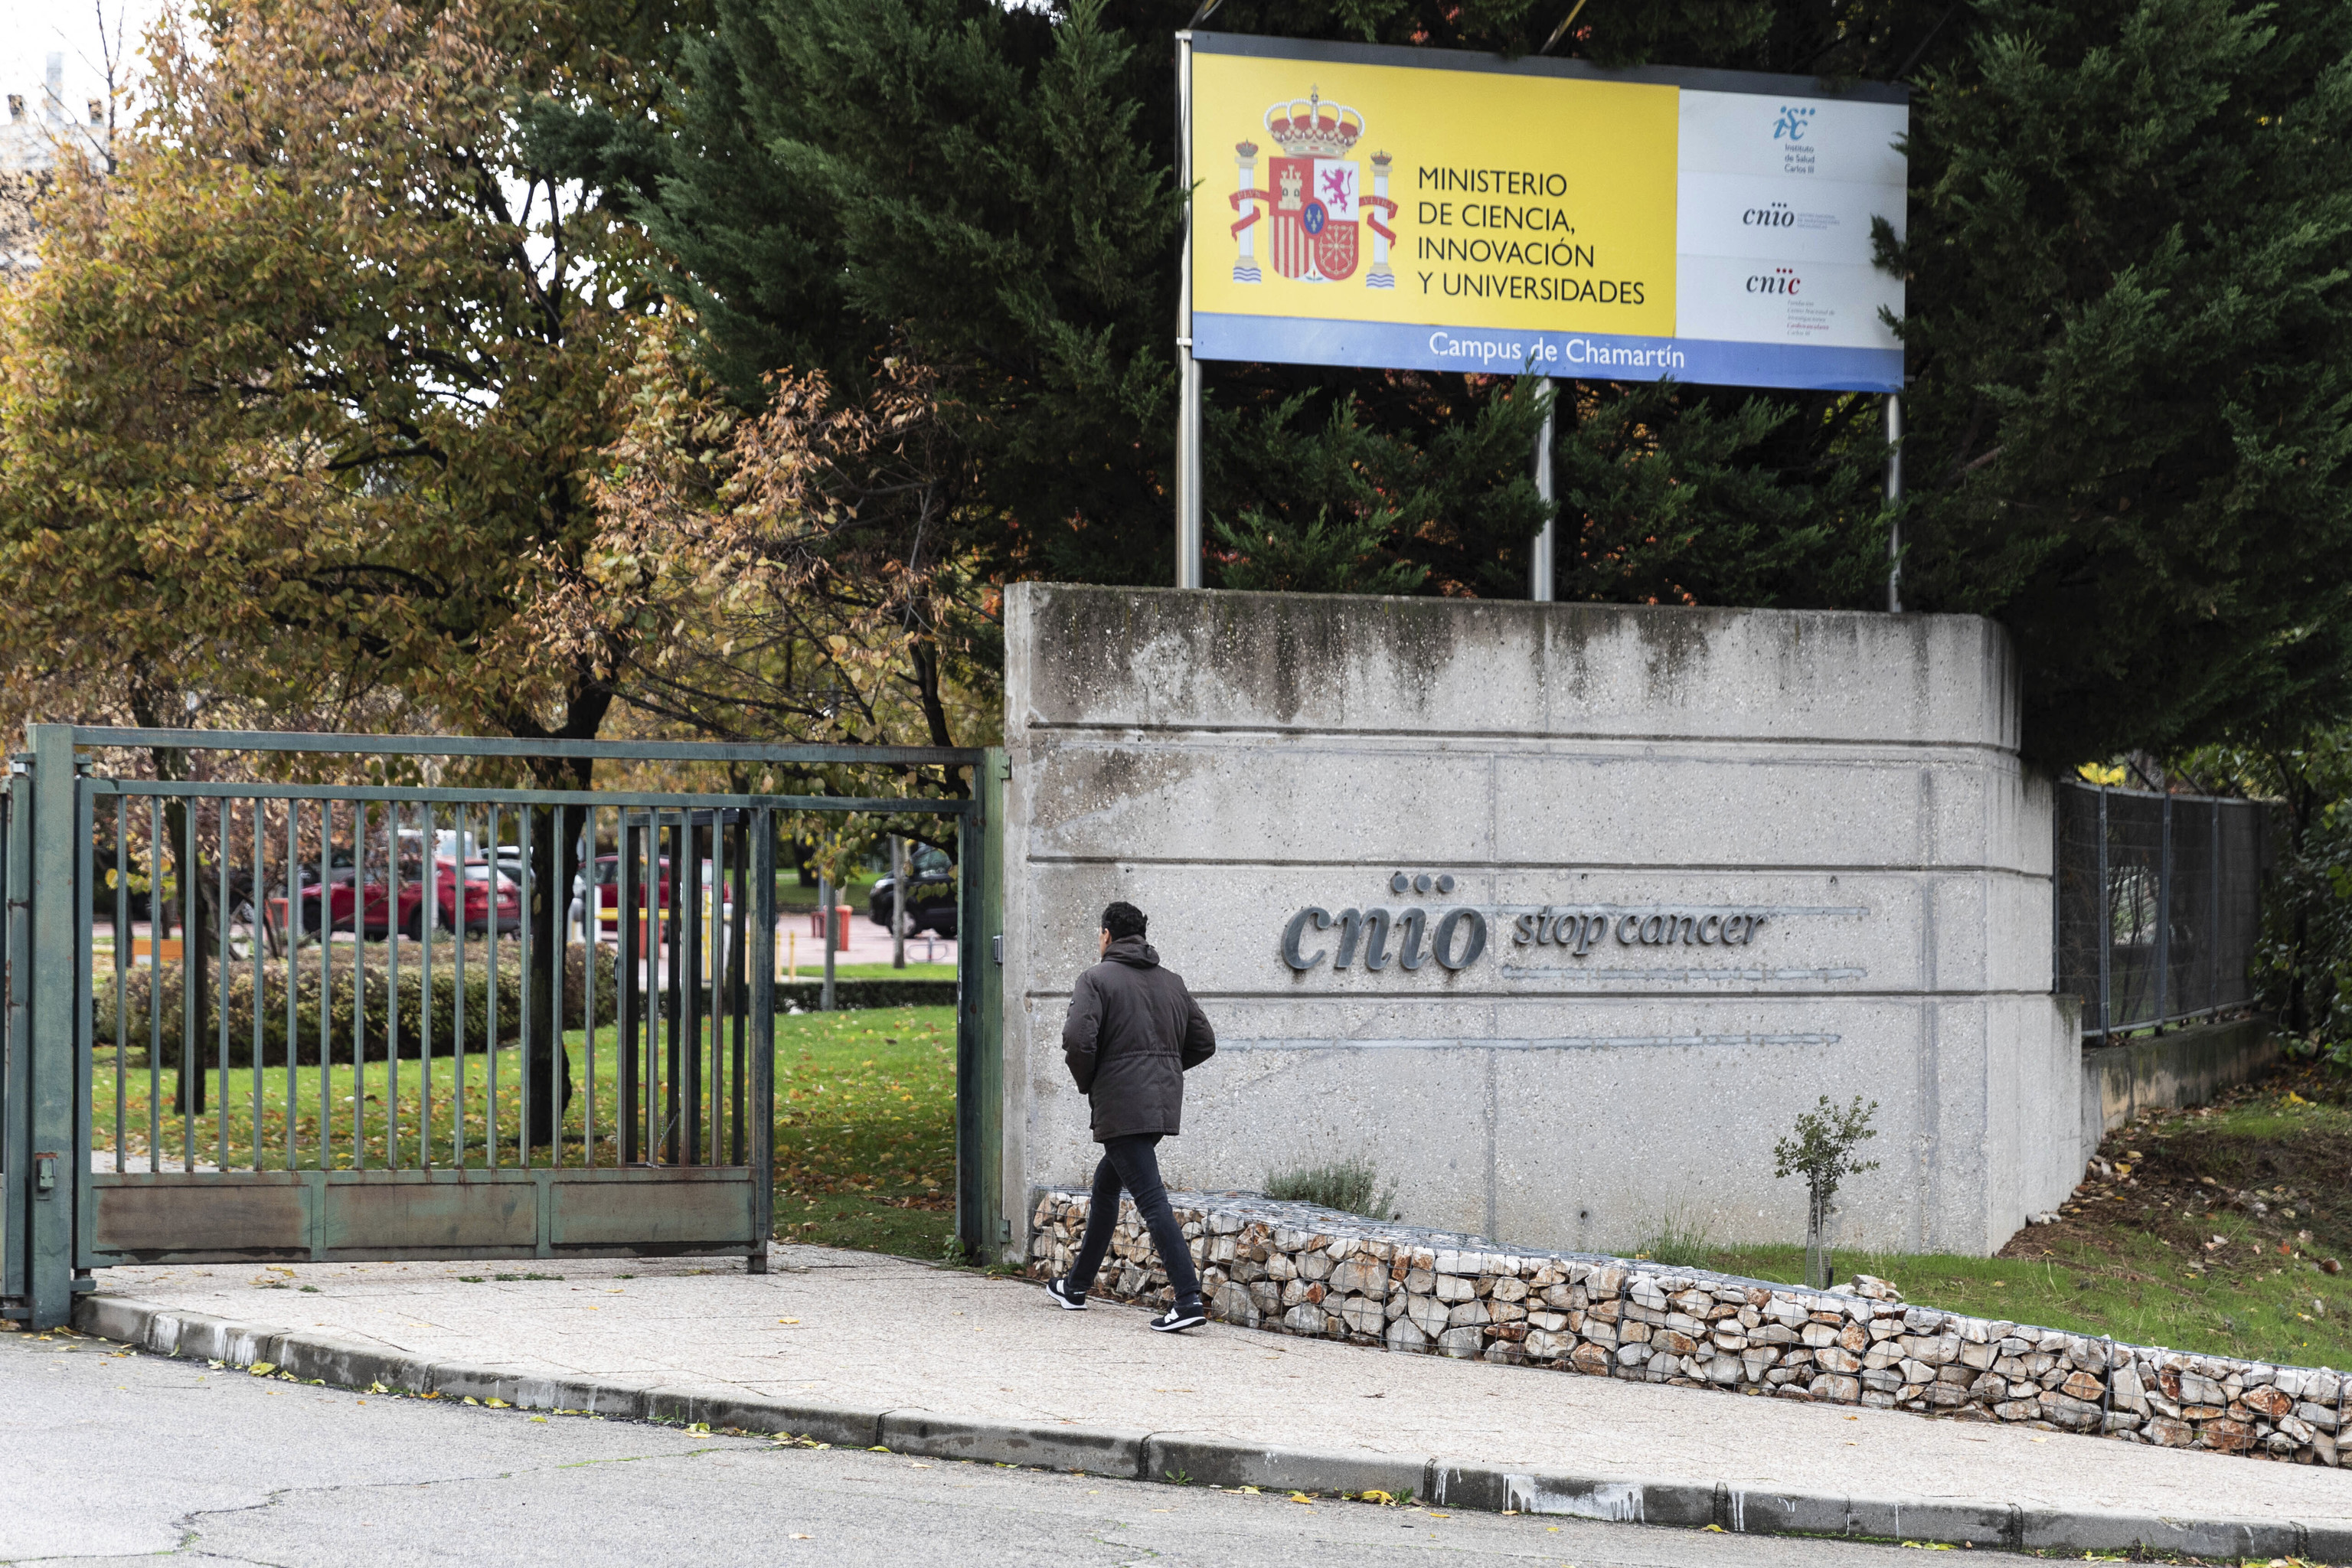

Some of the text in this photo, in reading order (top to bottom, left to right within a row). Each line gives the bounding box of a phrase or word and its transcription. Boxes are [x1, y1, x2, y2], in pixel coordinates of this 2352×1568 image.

[1785, 144, 1815, 154] Instituto
[1785, 154, 1815, 164] de Salud
[1419, 166, 1567, 197] MINISTERIO
[1784, 163, 1806, 174] Carlos
[1419, 201, 1576, 236] DE CIENCIA,
[1743, 201, 1795, 227] cnio
[1418, 237, 1594, 268] INNOVACIÓN
[1417, 271, 1645, 305] Y UNIVERSIDADES
[1746, 267, 1801, 296] cnic
[1429, 331, 1686, 369] Campus de Chamartín
[1280, 874, 1488, 971] cnio
[1512, 905, 1767, 956] stop cancer
